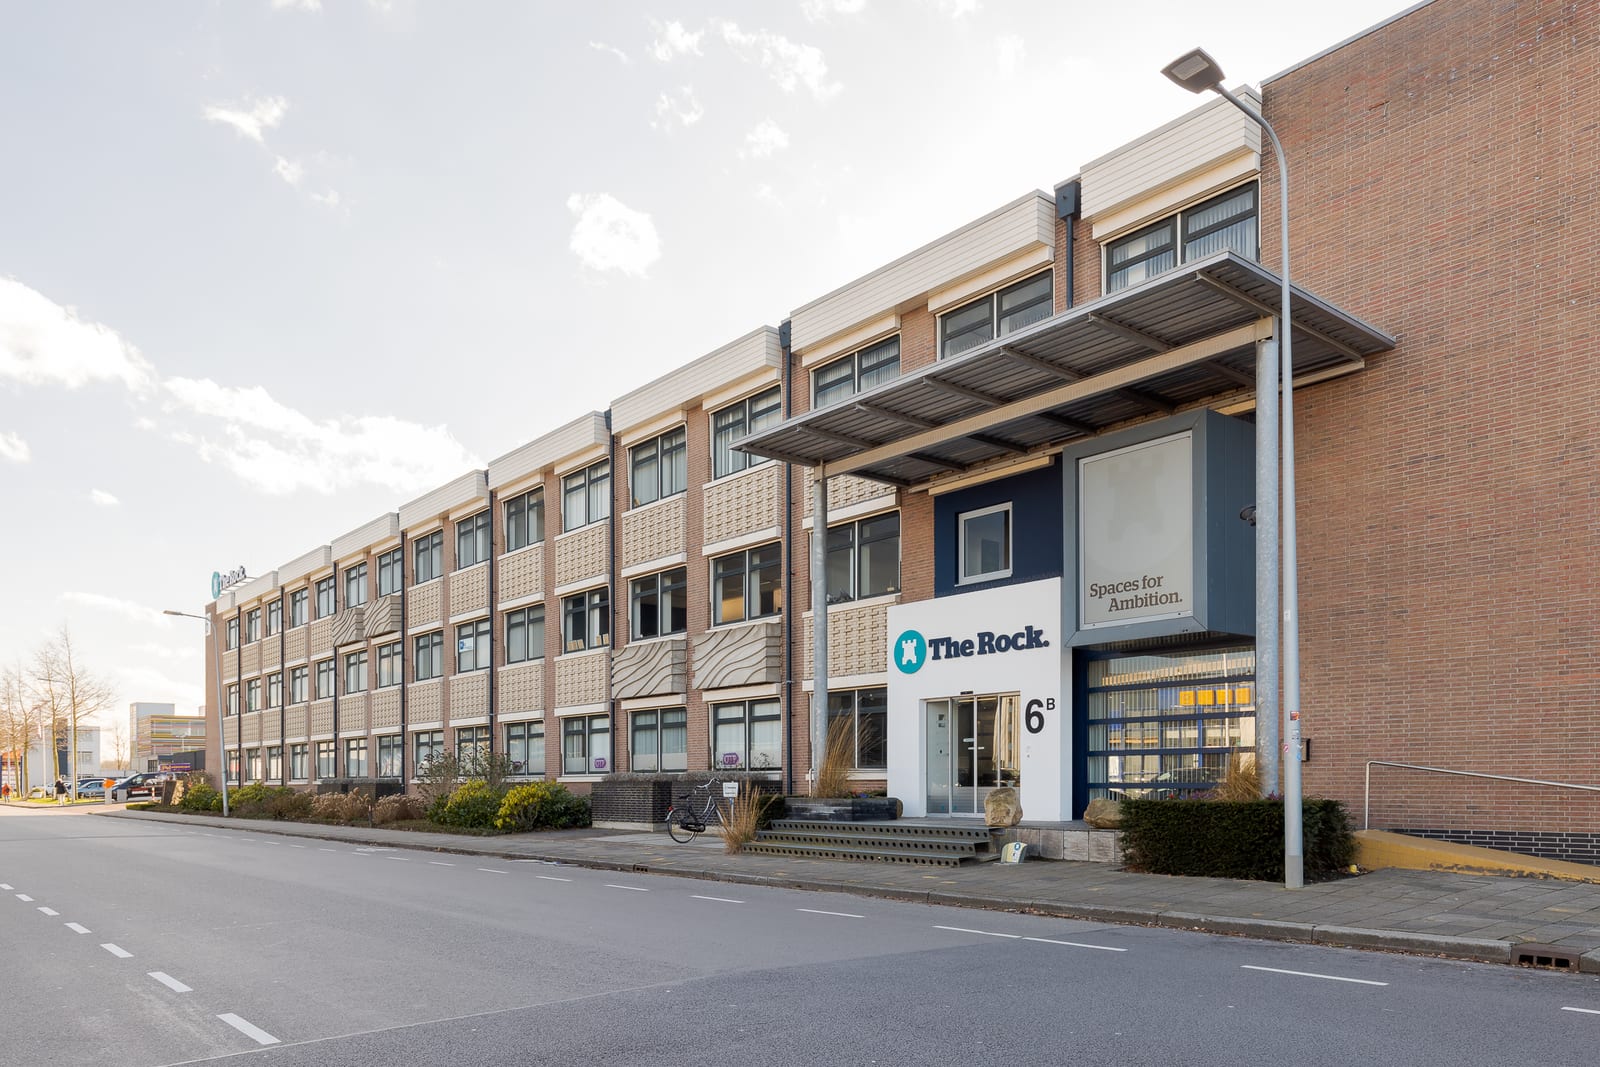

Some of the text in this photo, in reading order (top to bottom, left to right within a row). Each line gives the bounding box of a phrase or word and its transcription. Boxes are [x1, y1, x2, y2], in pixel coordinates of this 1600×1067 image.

[1089, 575, 1164, 599] Spaces for
[1108, 591, 1183, 613] Ambition.
[928, 625, 1050, 661] The Rock.
